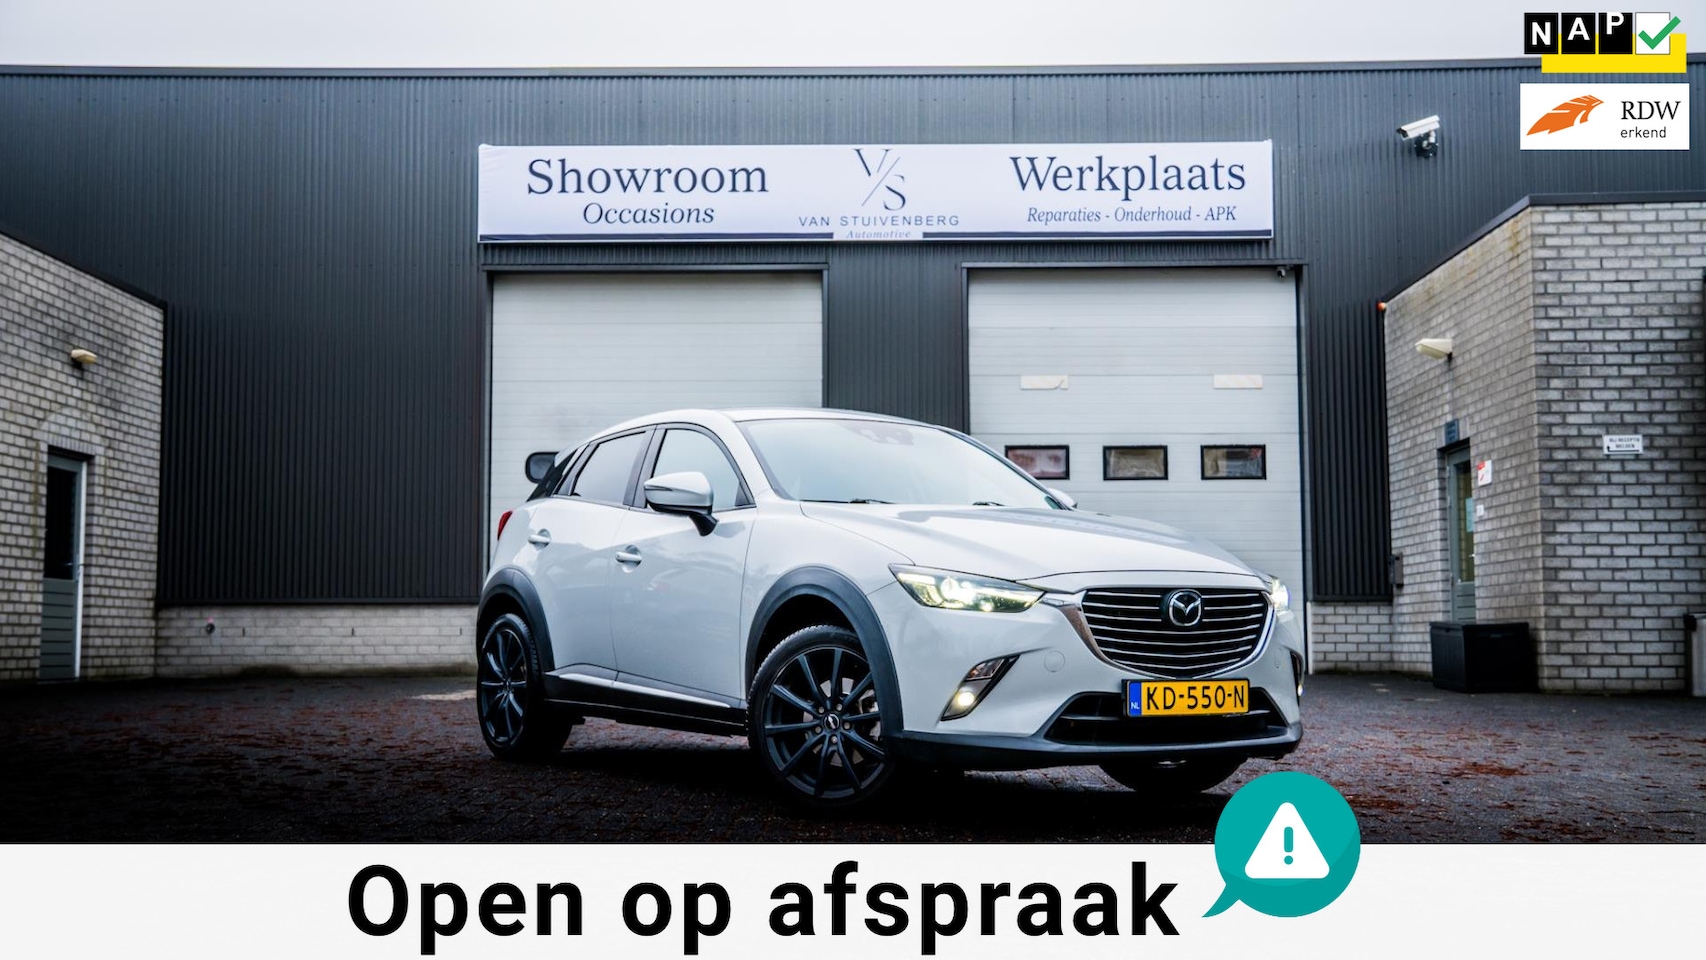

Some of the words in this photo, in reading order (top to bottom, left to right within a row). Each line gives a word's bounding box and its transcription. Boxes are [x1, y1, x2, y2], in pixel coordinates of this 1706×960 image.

[526, 157, 769, 195] Showroom
[1009, 154, 1246, 201] Werkplaats
[582, 202, 715, 225] Occasions
[798, 215, 831, 227] VAN
[838, 215, 960, 227] STUIVENBERG
[1026, 206, 1102, 224] Reparaties
[1113, 206, 1192, 223] Onderhoud
[1204, 205, 1237, 222] APK
[845, 229, 911, 240] Automotive
[1130, 701, 1140, 710] NL
[1146, 685, 1245, 710] KD-550-N
